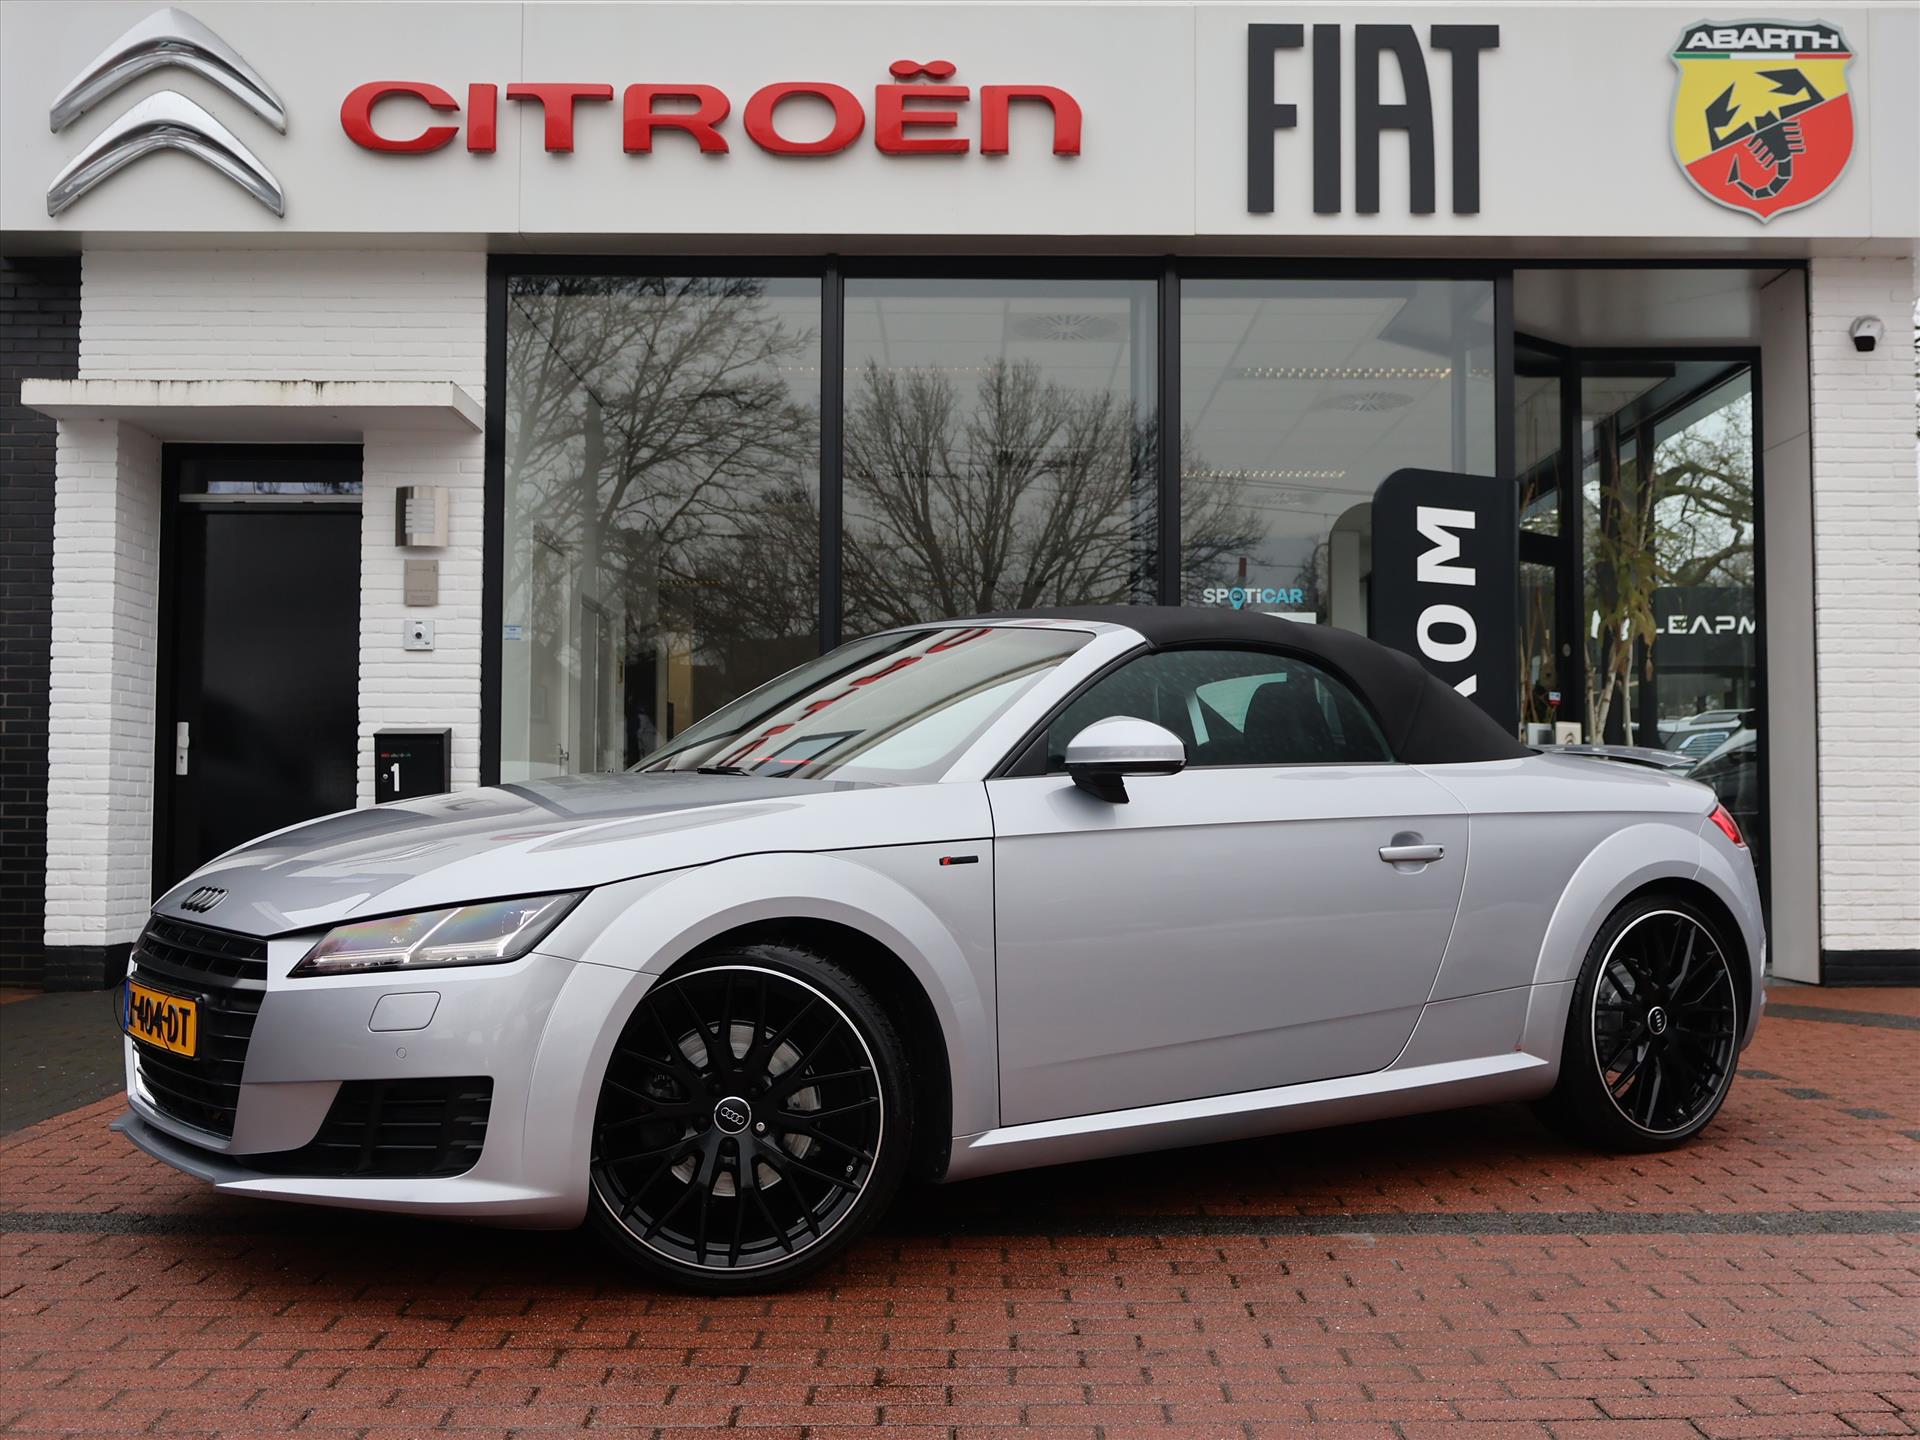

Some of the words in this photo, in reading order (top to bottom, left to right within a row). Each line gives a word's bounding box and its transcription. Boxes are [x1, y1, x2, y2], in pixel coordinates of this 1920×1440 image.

[1685, 27, 1840, 50] ABARTH
[1247, 23, 1500, 215] FIAT
[1416, 505, 1478, 698] OM
[390, 762, 401, 792] 1
